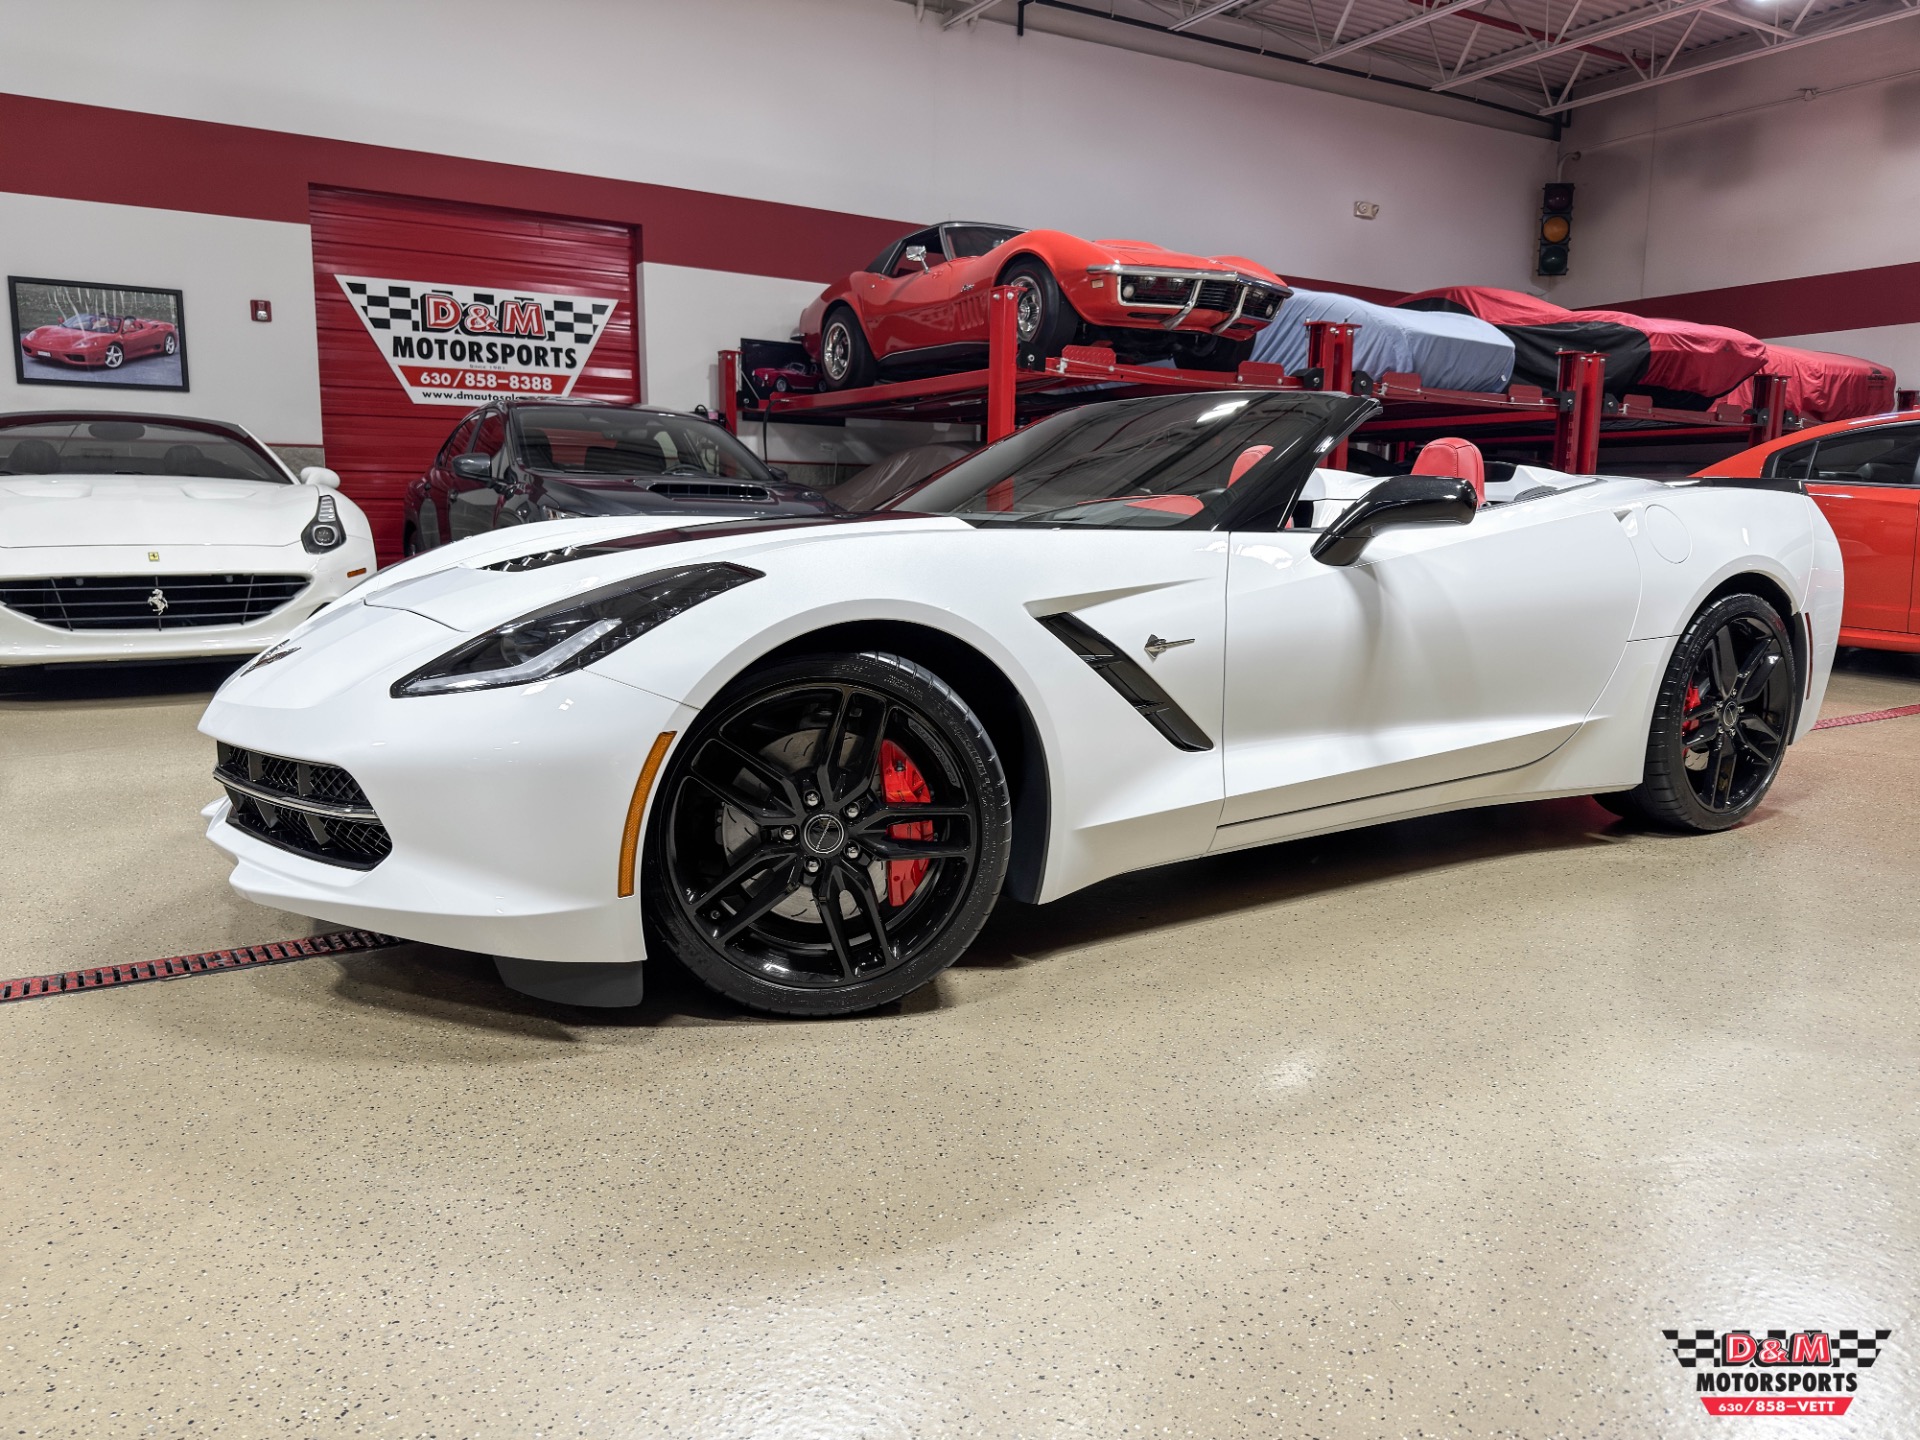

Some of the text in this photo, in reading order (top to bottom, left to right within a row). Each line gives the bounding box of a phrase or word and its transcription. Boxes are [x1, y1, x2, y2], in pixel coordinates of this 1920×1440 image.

[421, 294, 547, 339] D&M
[392, 335, 578, 369] MOTORSPORTS
[420, 371, 553, 391] 630/858-8388
